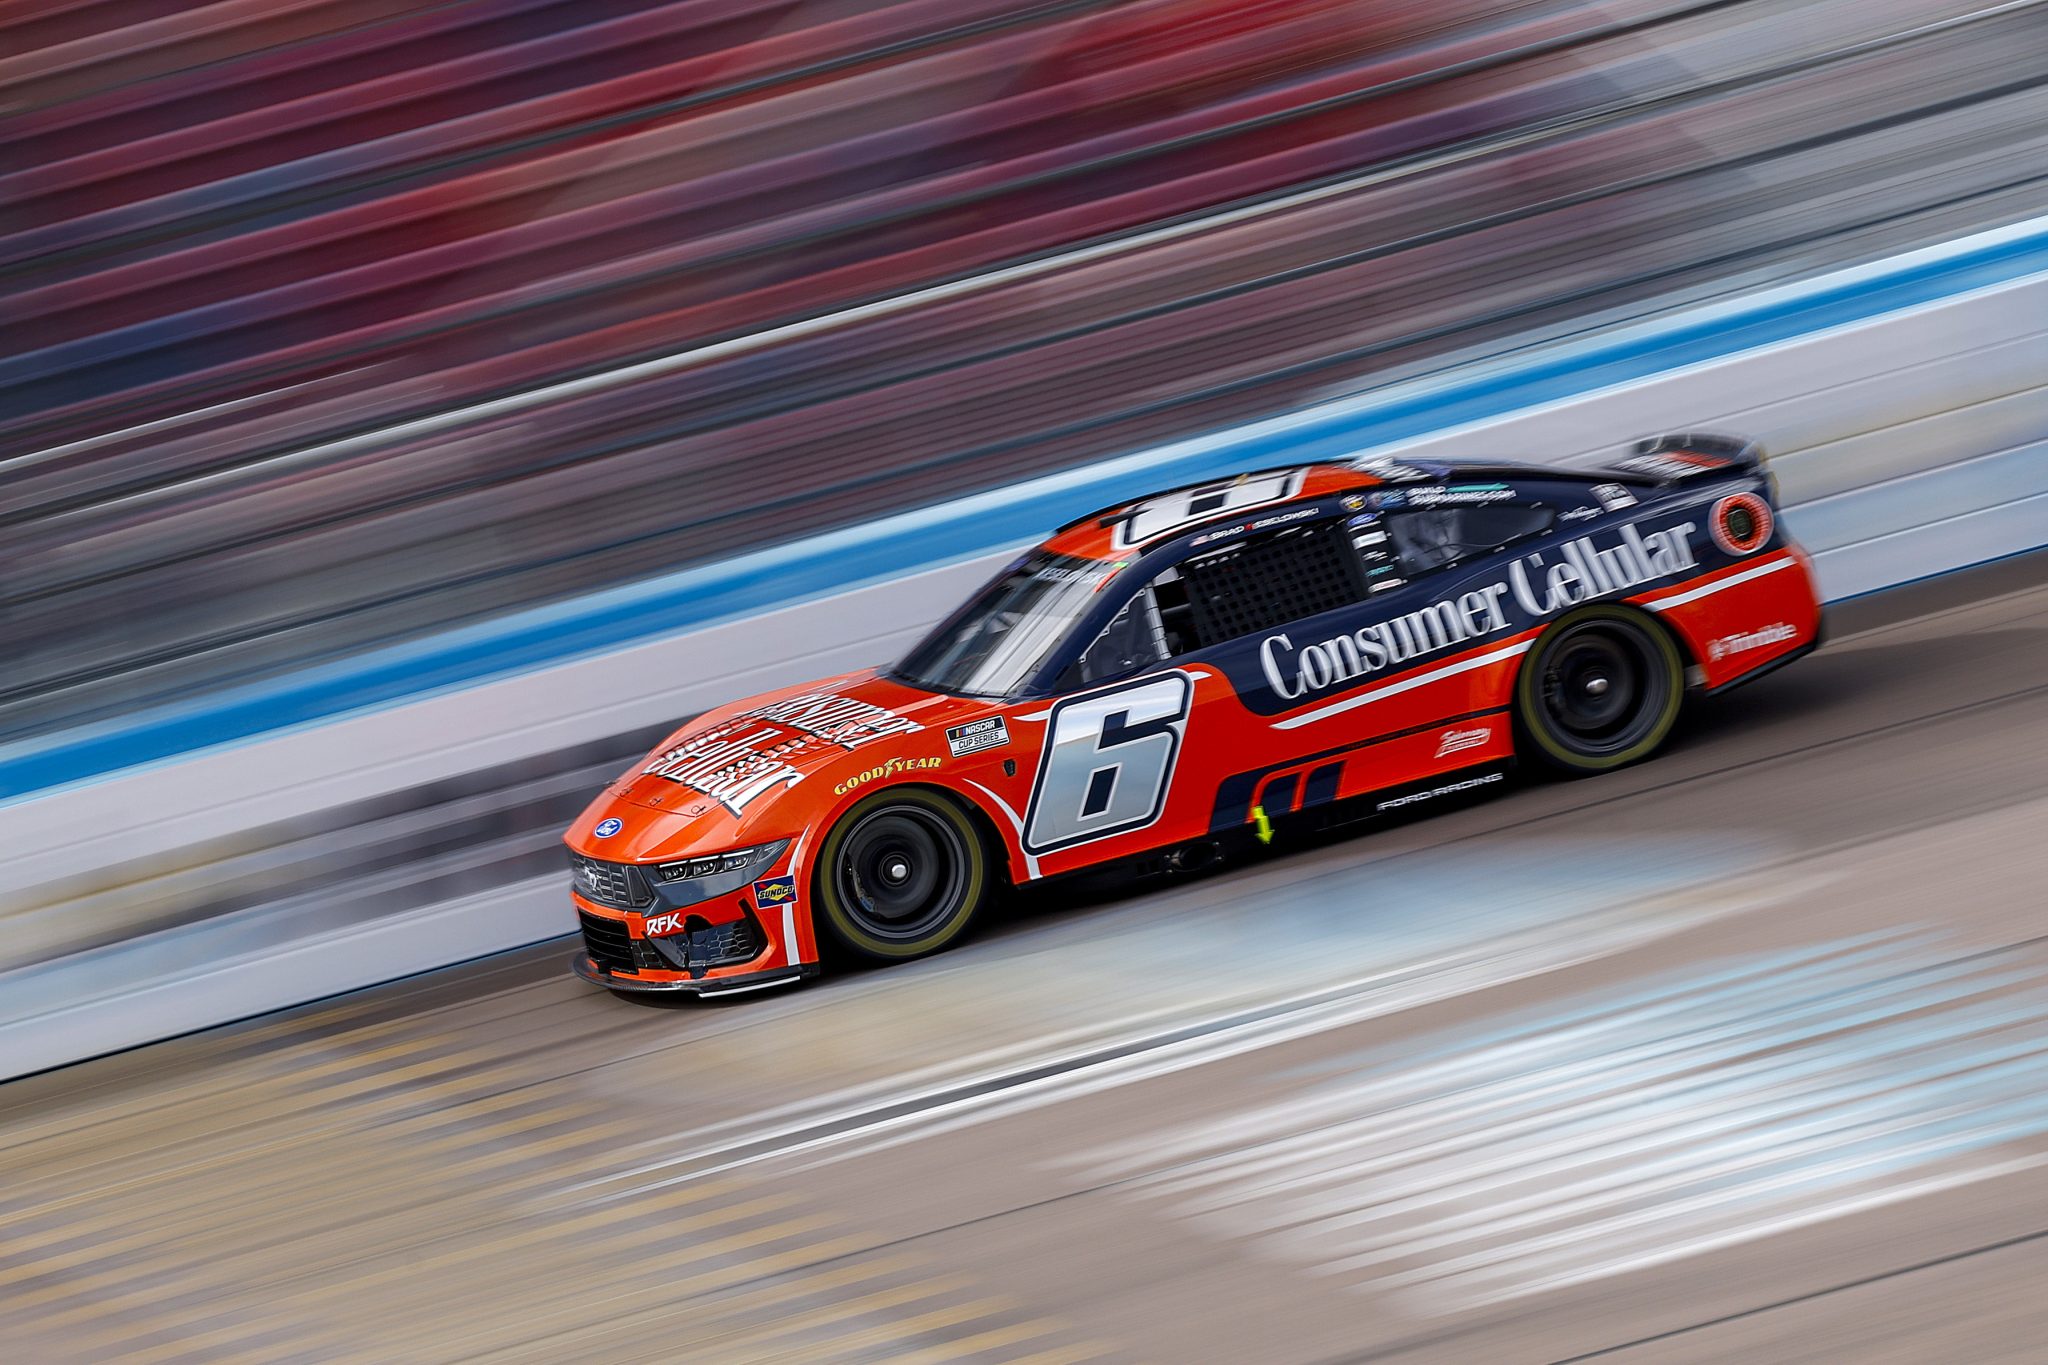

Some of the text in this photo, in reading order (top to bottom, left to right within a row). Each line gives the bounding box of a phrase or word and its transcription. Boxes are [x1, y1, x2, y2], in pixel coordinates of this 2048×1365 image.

[1209, 525, 1245, 541] BRAD
[1260, 521, 1699, 700] Consumer Cellular
[957, 731, 1000, 750] CUP SERIES
[964, 719, 996, 736] NASCAR
[1022, 669, 1193, 855] 6
[833, 756, 943, 796] GOODYEAR
[1376, 772, 1504, 812] FORD RACING
[757, 886, 795, 901] SUNOCO
[646, 911, 685, 937] RFK
